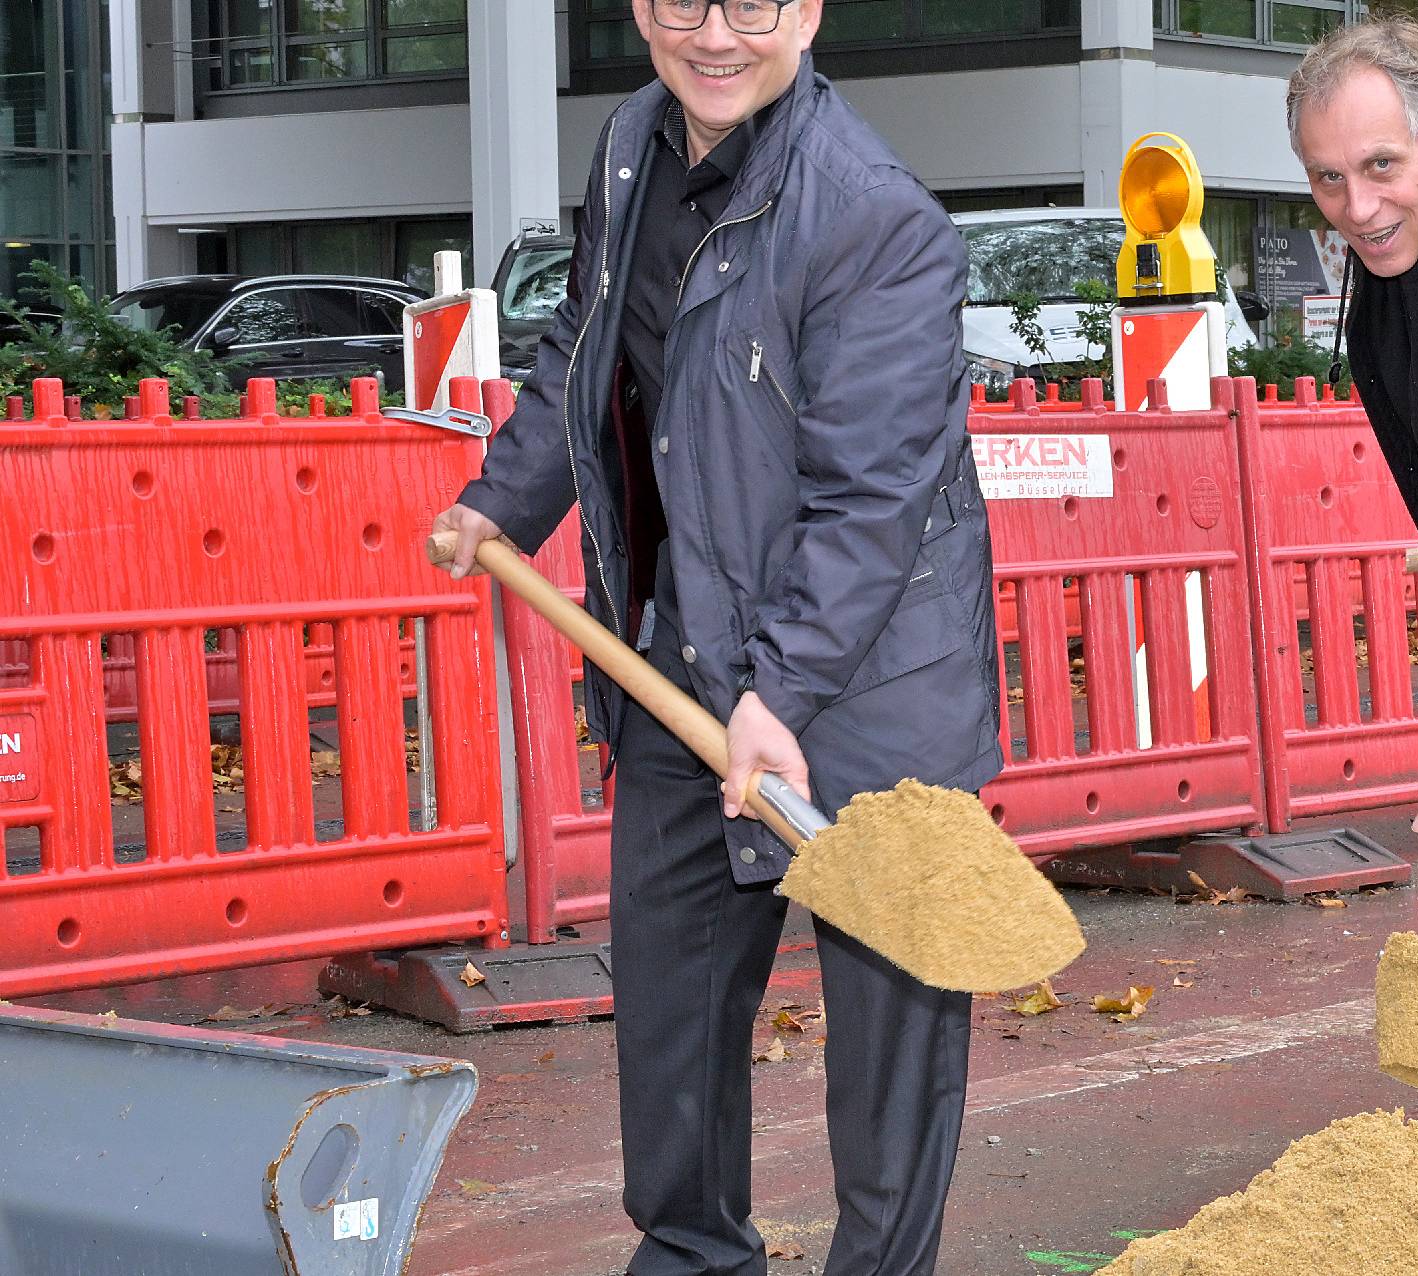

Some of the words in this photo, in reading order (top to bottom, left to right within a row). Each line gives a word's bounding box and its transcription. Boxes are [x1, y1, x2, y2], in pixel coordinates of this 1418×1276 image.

[972, 437, 1087, 467] ERKEN
[980, 471, 1088, 481] LEN-ABSPERR-SERVICE
[0, 733, 21, 755] N
